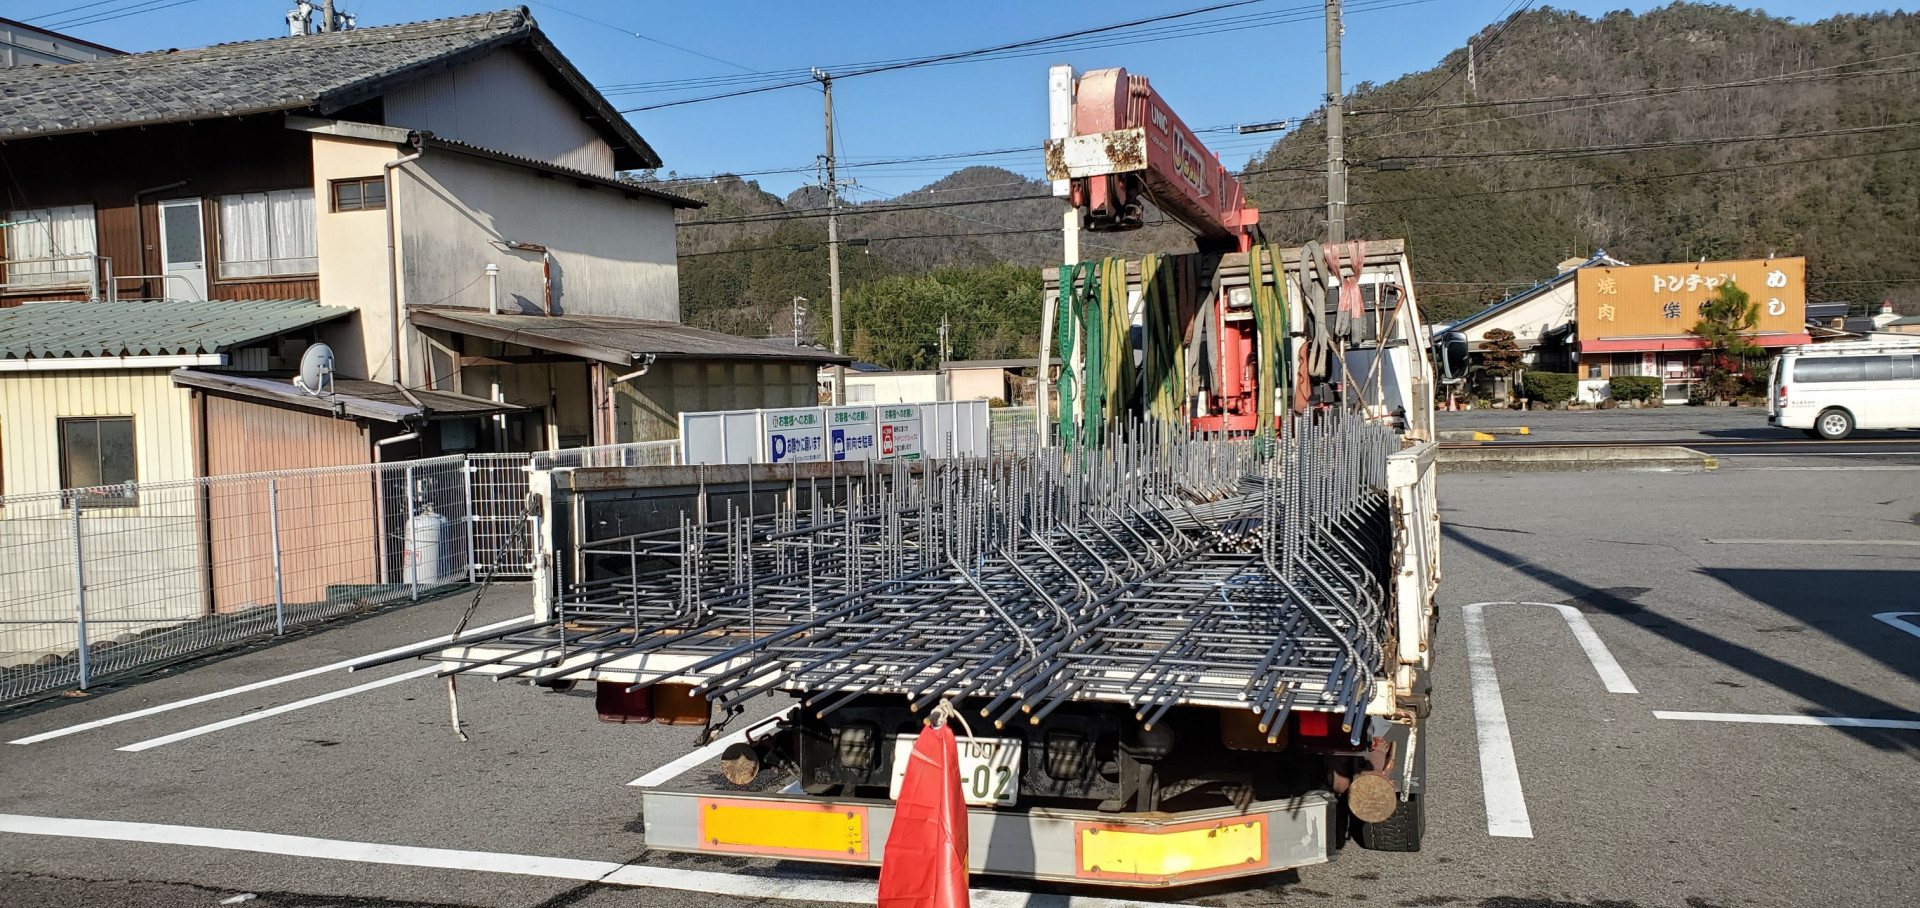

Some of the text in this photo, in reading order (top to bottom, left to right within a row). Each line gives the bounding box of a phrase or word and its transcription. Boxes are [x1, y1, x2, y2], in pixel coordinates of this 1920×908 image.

[1150, 103, 1169, 136] UNIC
[1597, 276, 1617, 322] 焼肉
[1766, 270, 1788, 317] めし
[779, 414, 818, 427] お客様へのお願い
[835, 411, 869, 422] お客様へのお願い
[846, 435, 873, 451] 前向き駐車
